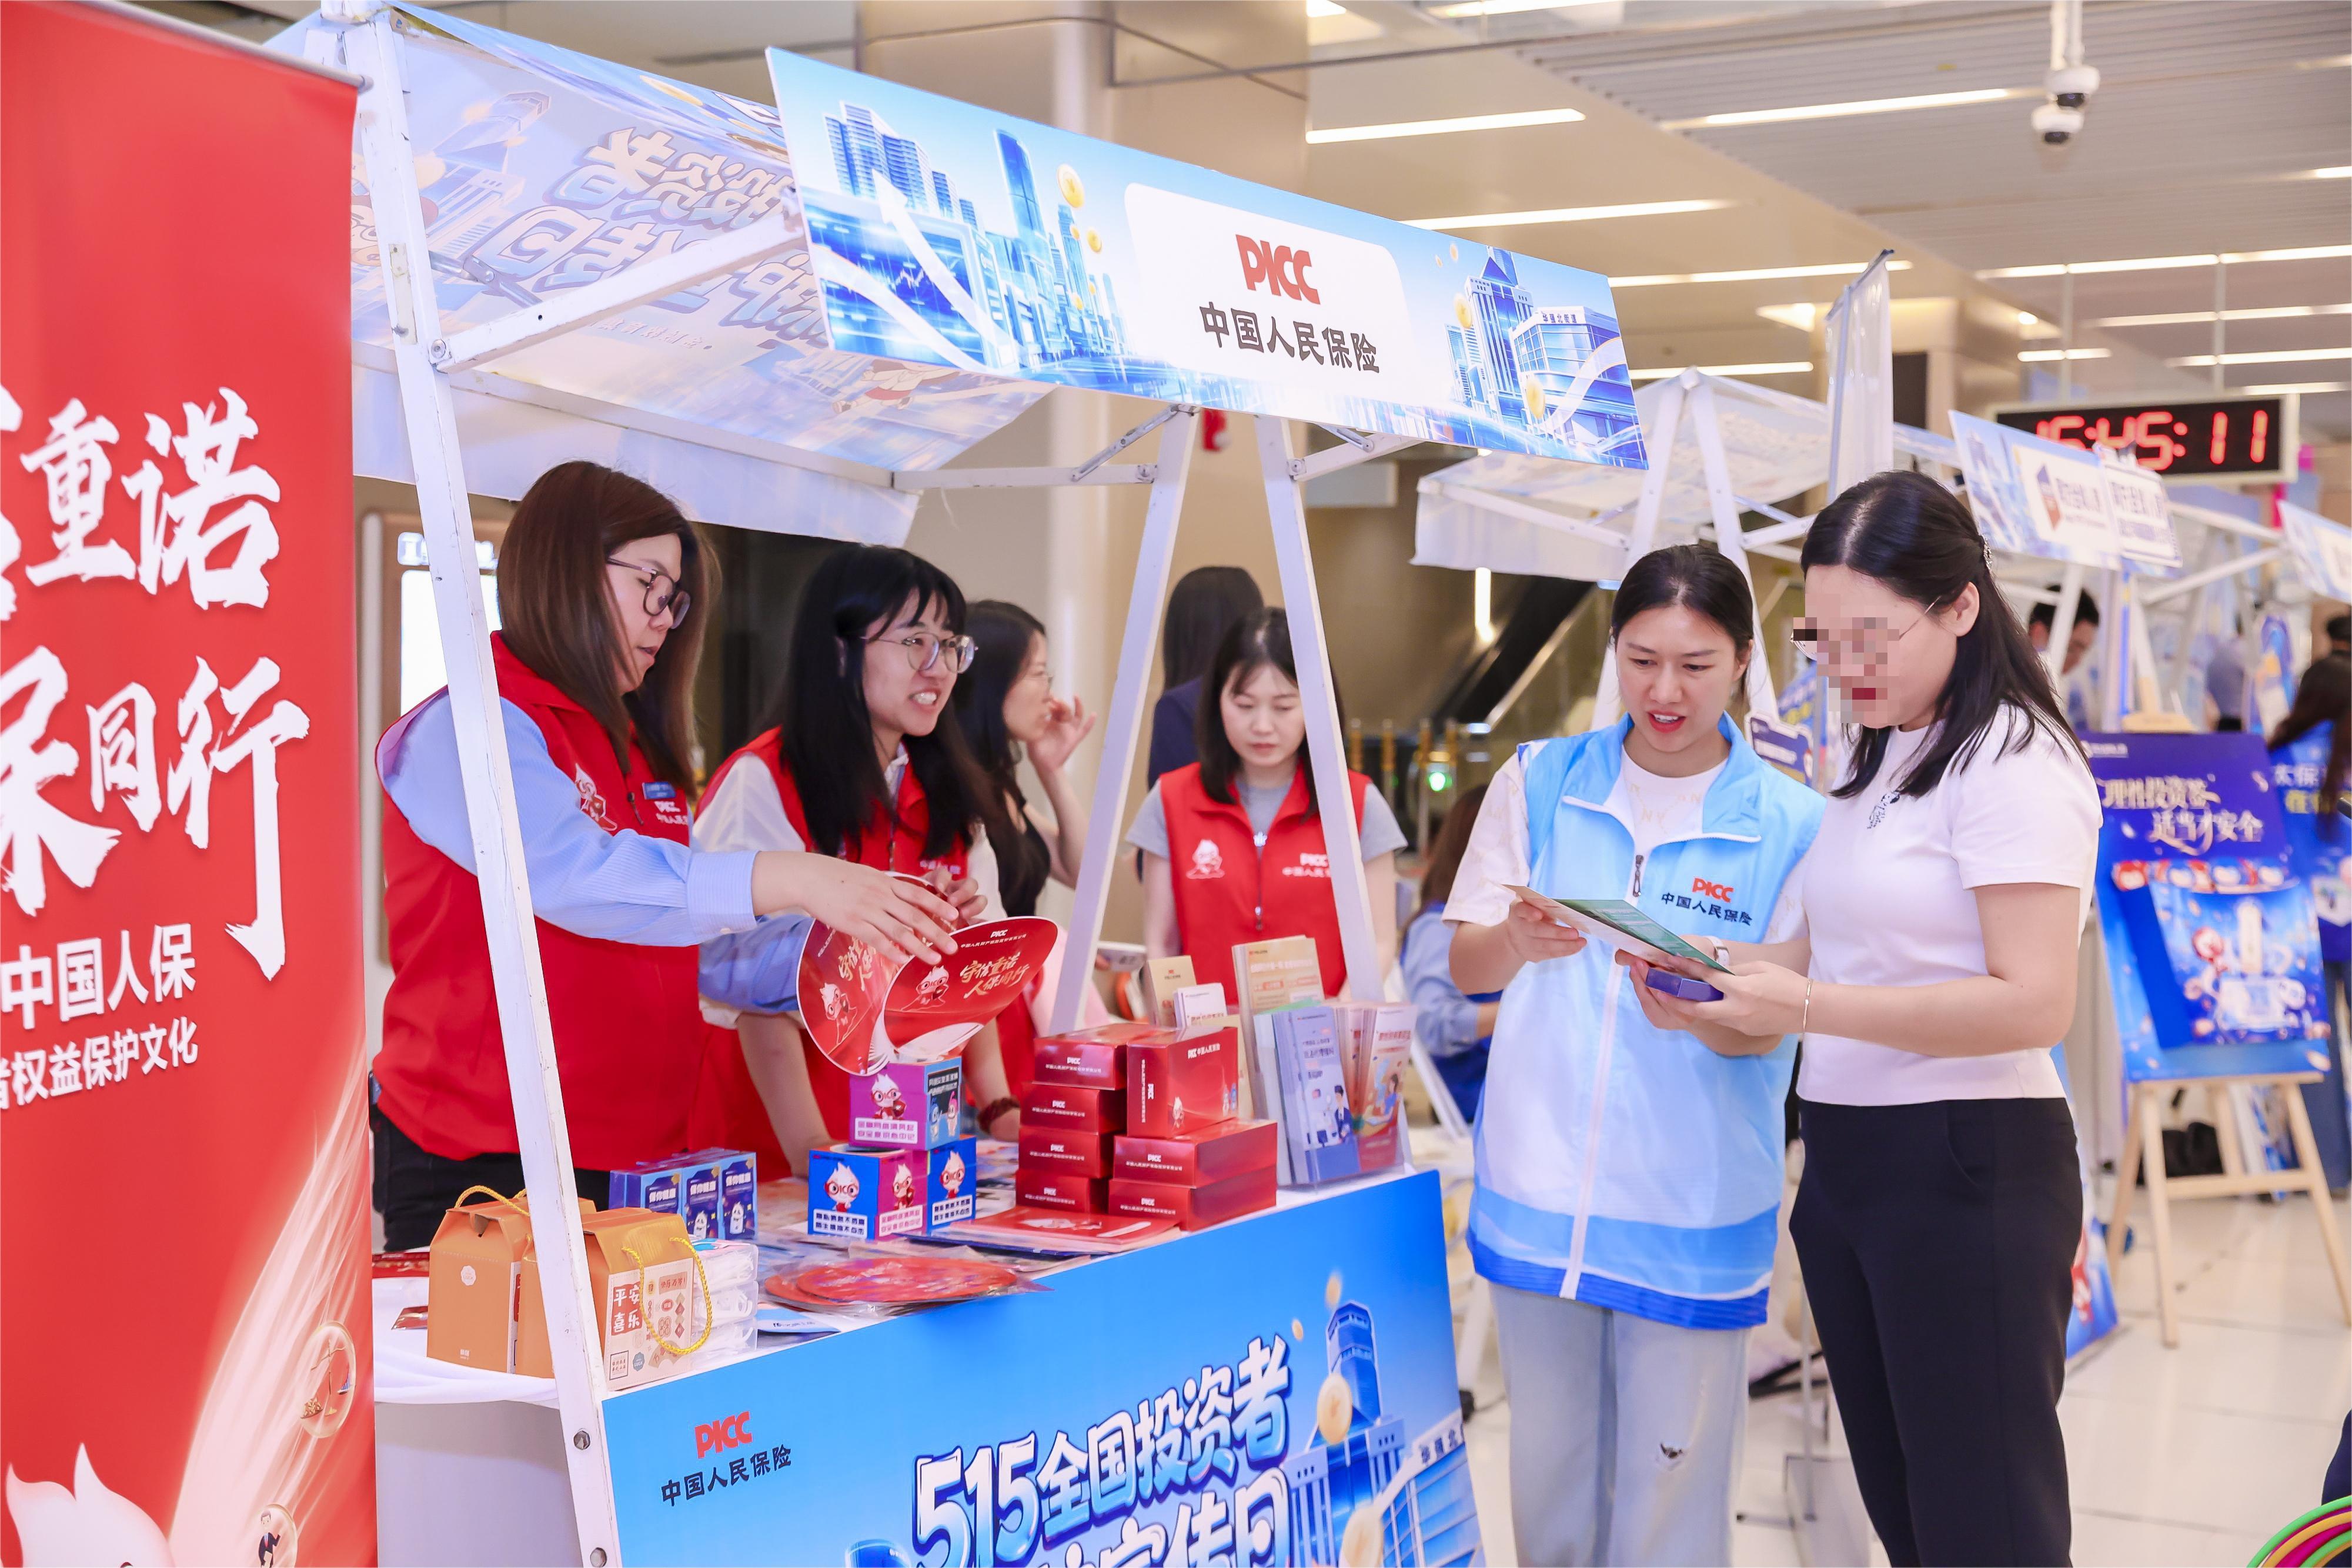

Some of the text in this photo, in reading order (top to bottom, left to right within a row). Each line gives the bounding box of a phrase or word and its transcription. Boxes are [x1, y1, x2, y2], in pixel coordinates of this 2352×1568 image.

[1235, 234, 1321, 305] PICC
[1200, 302, 1379, 373] 中国人民保险
[0, 384, 280, 620] 重诺
[1661, 891, 1753, 926] 中国人民保险
[1692, 877, 1734, 903] PICC
[990, 929, 1008, 938] PICC
[0, 922, 196, 1030] 中国人保
[959, 951, 1021, 984] 守信重诺
[613, 1309, 640, 1333] 喜乐
[694, 1410, 753, 1459] PICC
[916, 1333, 1290, 1568] 515全国投资者
[660, 1444, 791, 1507] 中国人民保险
